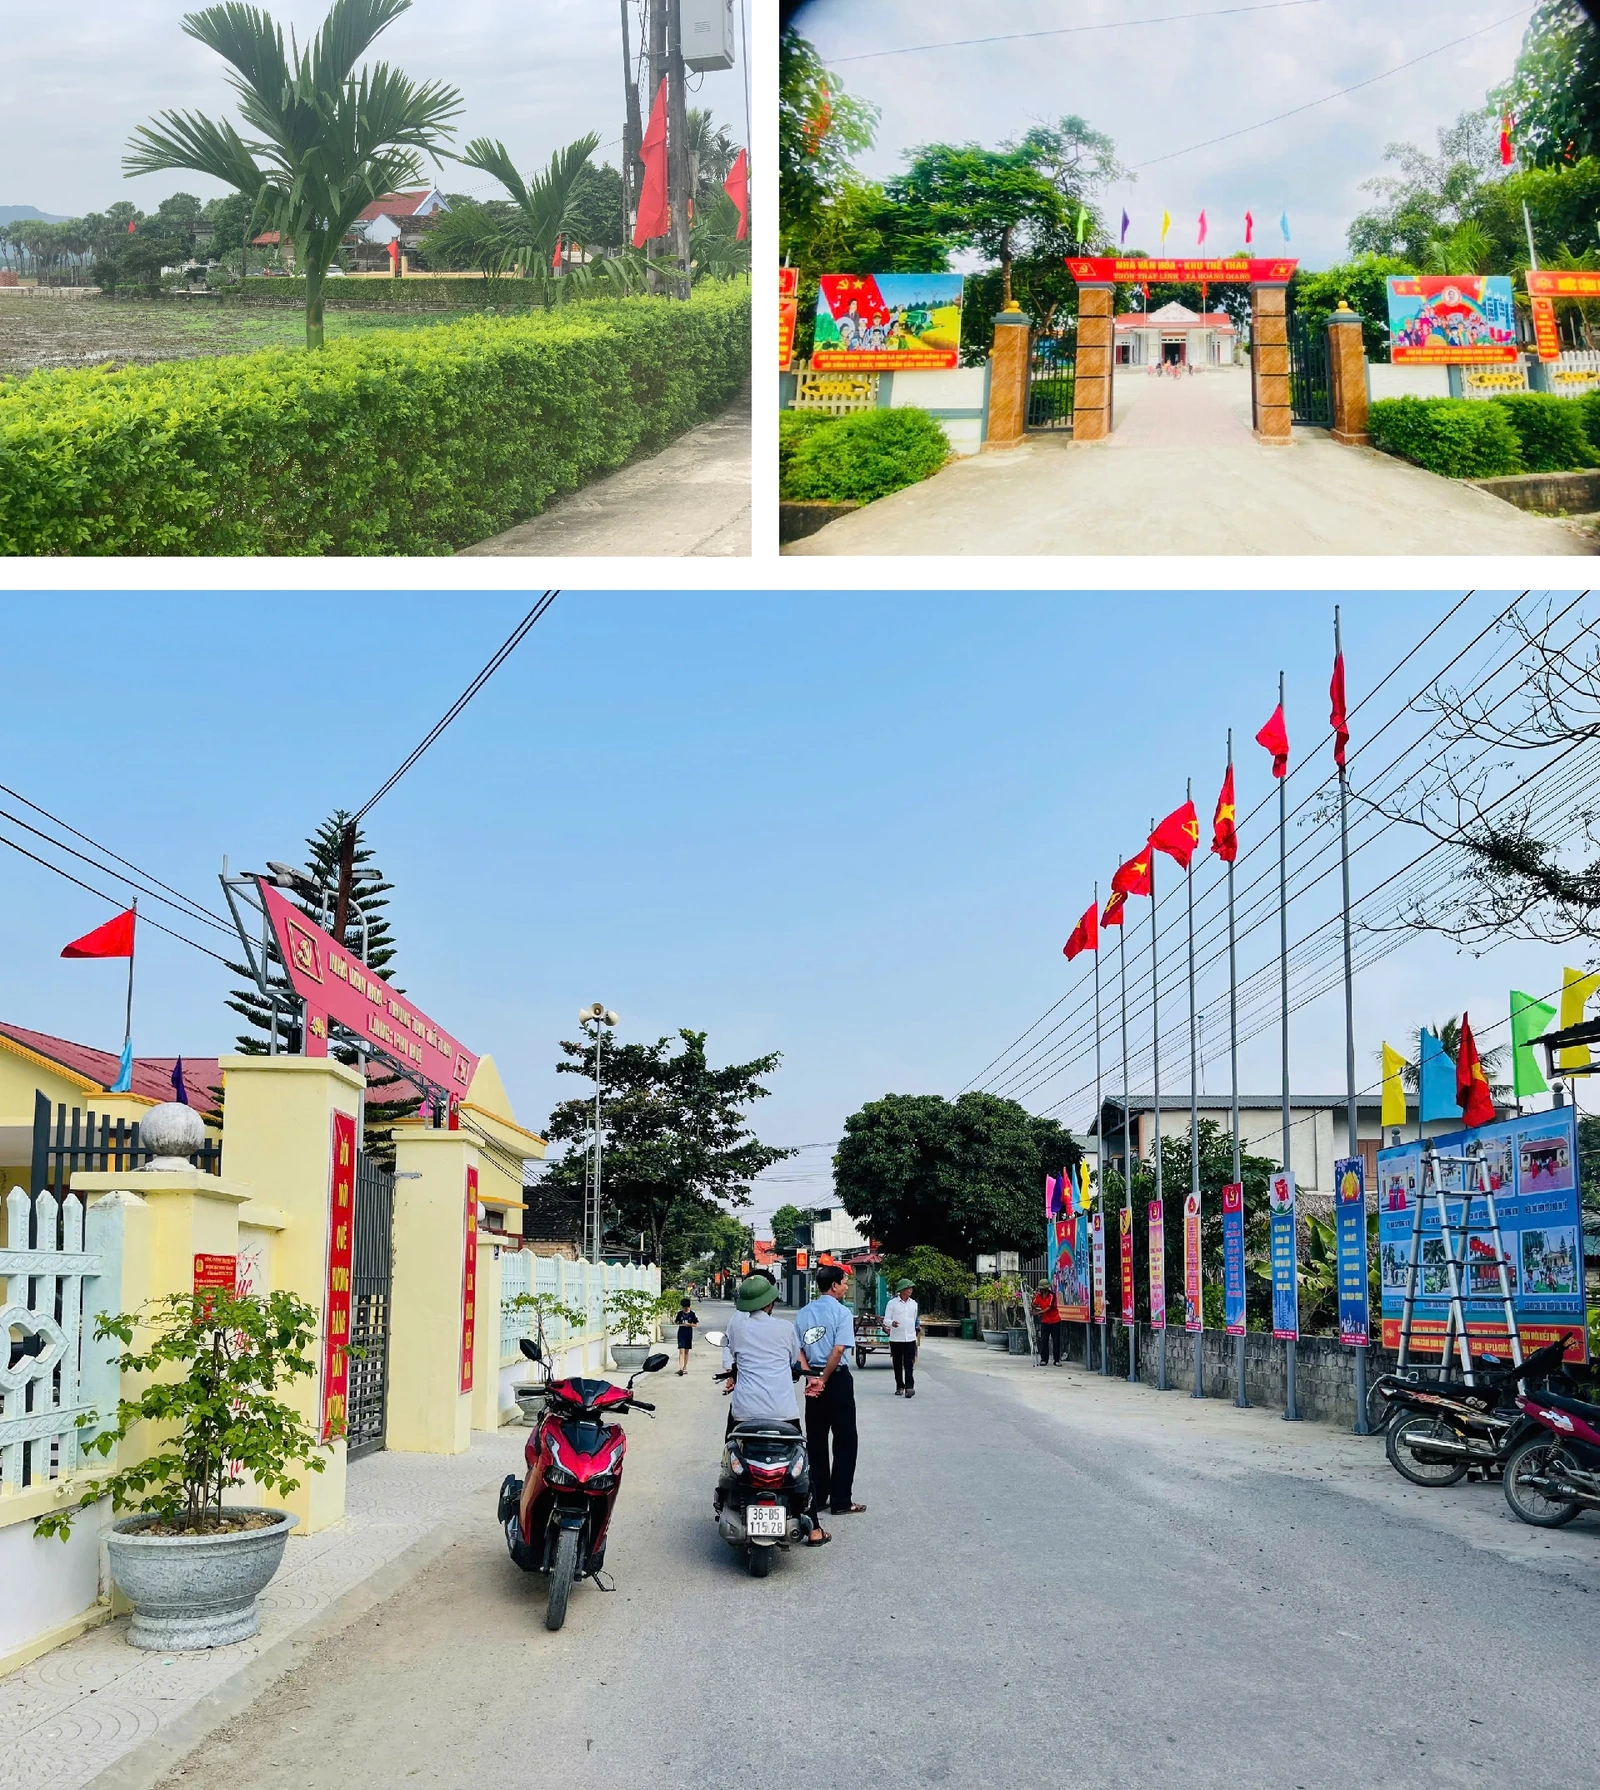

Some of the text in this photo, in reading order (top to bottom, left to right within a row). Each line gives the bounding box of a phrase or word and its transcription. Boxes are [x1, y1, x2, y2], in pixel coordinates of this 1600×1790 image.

[1184, 261, 1204, 270] KHU
[1225, 261, 1248, 270] THAO
[328, 951, 349, 982] NHÀ
[348, 966, 366, 994] VĂN
[387, 997, 412, 1028] TRUNG
[437, 1036, 453, 1059] THAO
[336, 1220, 347, 1252] QUÊ
[752, 1508, 780, 1520] 36-B5
[750, 1522, 783, 1534] 115.28
